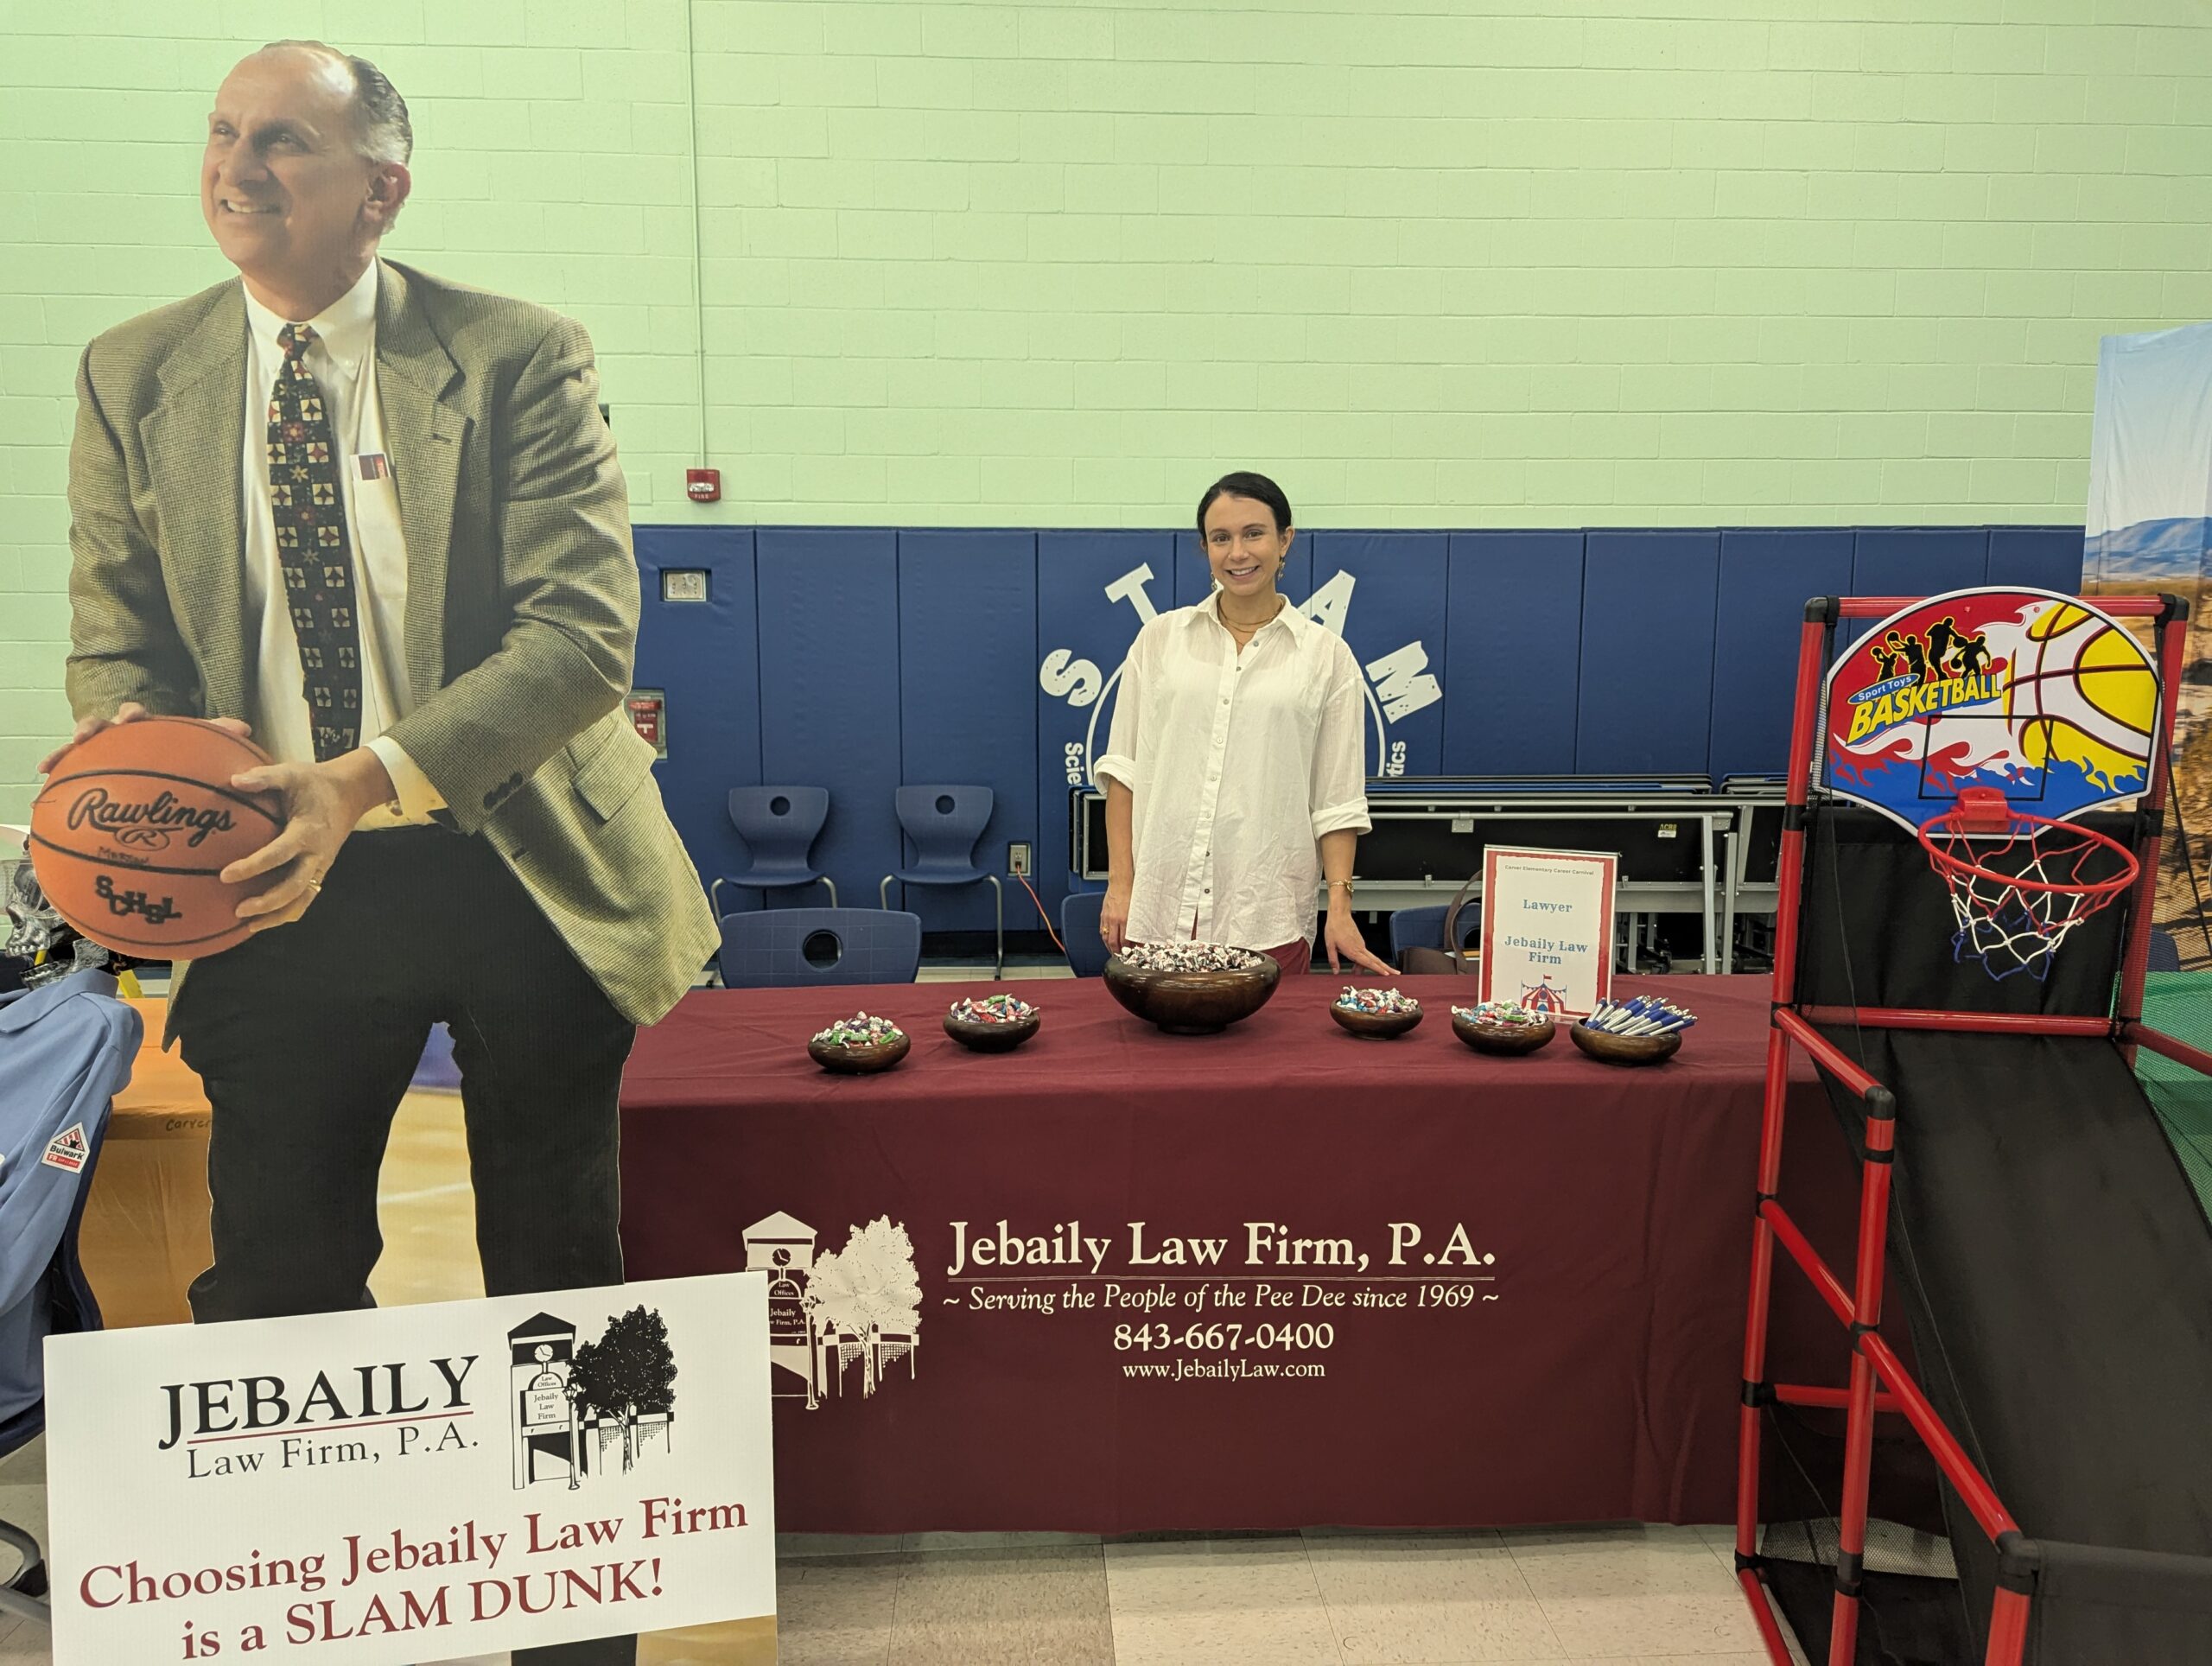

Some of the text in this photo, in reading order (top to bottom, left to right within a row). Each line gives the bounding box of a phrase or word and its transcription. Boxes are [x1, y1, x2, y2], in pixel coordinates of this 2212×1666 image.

[1859, 676, 1912, 702] Sport Toys
[1846, 674, 2002, 747] BASKETBALL
[67, 787, 238, 848] Rawlings
[1523, 899, 1573, 913] Lawyer
[1504, 935, 1588, 953] Jebaily Law
[1529, 951, 1562, 964] Firm
[49, 1144, 85, 1160] Bulwark
[947, 1219, 1496, 1276] Jebaily Law Firm, P.A.
[770, 1308, 796, 1318] Jebaily
[969, 1285, 1057, 1314] Serving
[1062, 1284, 1096, 1309] the
[1103, 1284, 1176, 1313] People
[1184, 1283, 1210, 1313] of
[1213, 1284, 1246, 1307] the
[1254, 1284, 1294, 1307] Pee
[1301, 1284, 1345, 1307] Dee
[1352, 1287, 1408, 1308] since
[1417, 1284, 1474, 1307] 1969
[1113, 1322, 1334, 1351] 843-667-0400
[1122, 1358, 1325, 1382] www.JebailyLaw.com
[158, 1355, 479, 1450] JEBAILY
[534, 1393, 558, 1402] Jebaily
[186, 1421, 479, 1478] Law Firm, P.A.
[79, 1497, 748, 1608] Choosing Jebaily Law Firm
[182, 1557, 663, 1660] is a SLAM DUNK!
